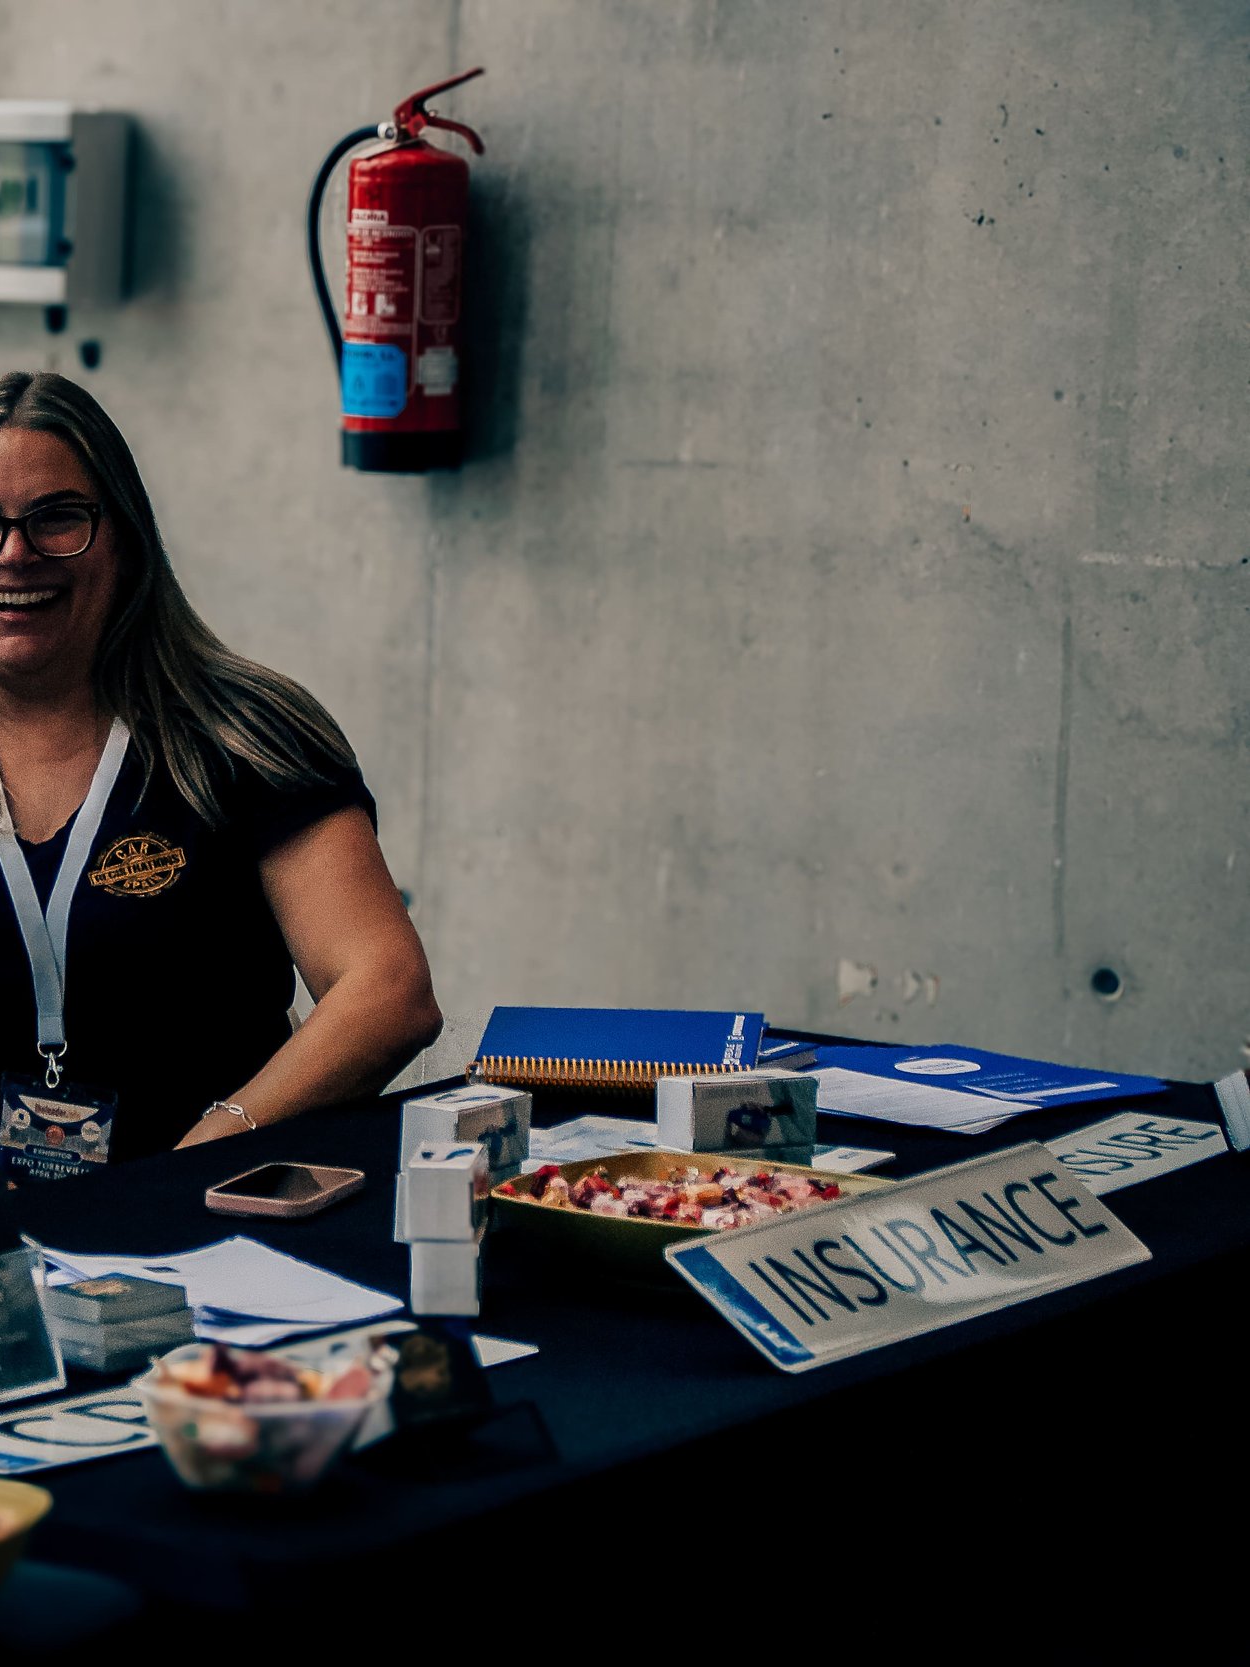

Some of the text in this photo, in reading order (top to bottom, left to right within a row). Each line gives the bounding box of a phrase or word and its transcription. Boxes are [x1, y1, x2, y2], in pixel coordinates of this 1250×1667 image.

[115, 841, 150, 860] CAR
[11, 1156, 35, 1168] EXPO
[747, 1172, 1111, 1326] INSURANCE
